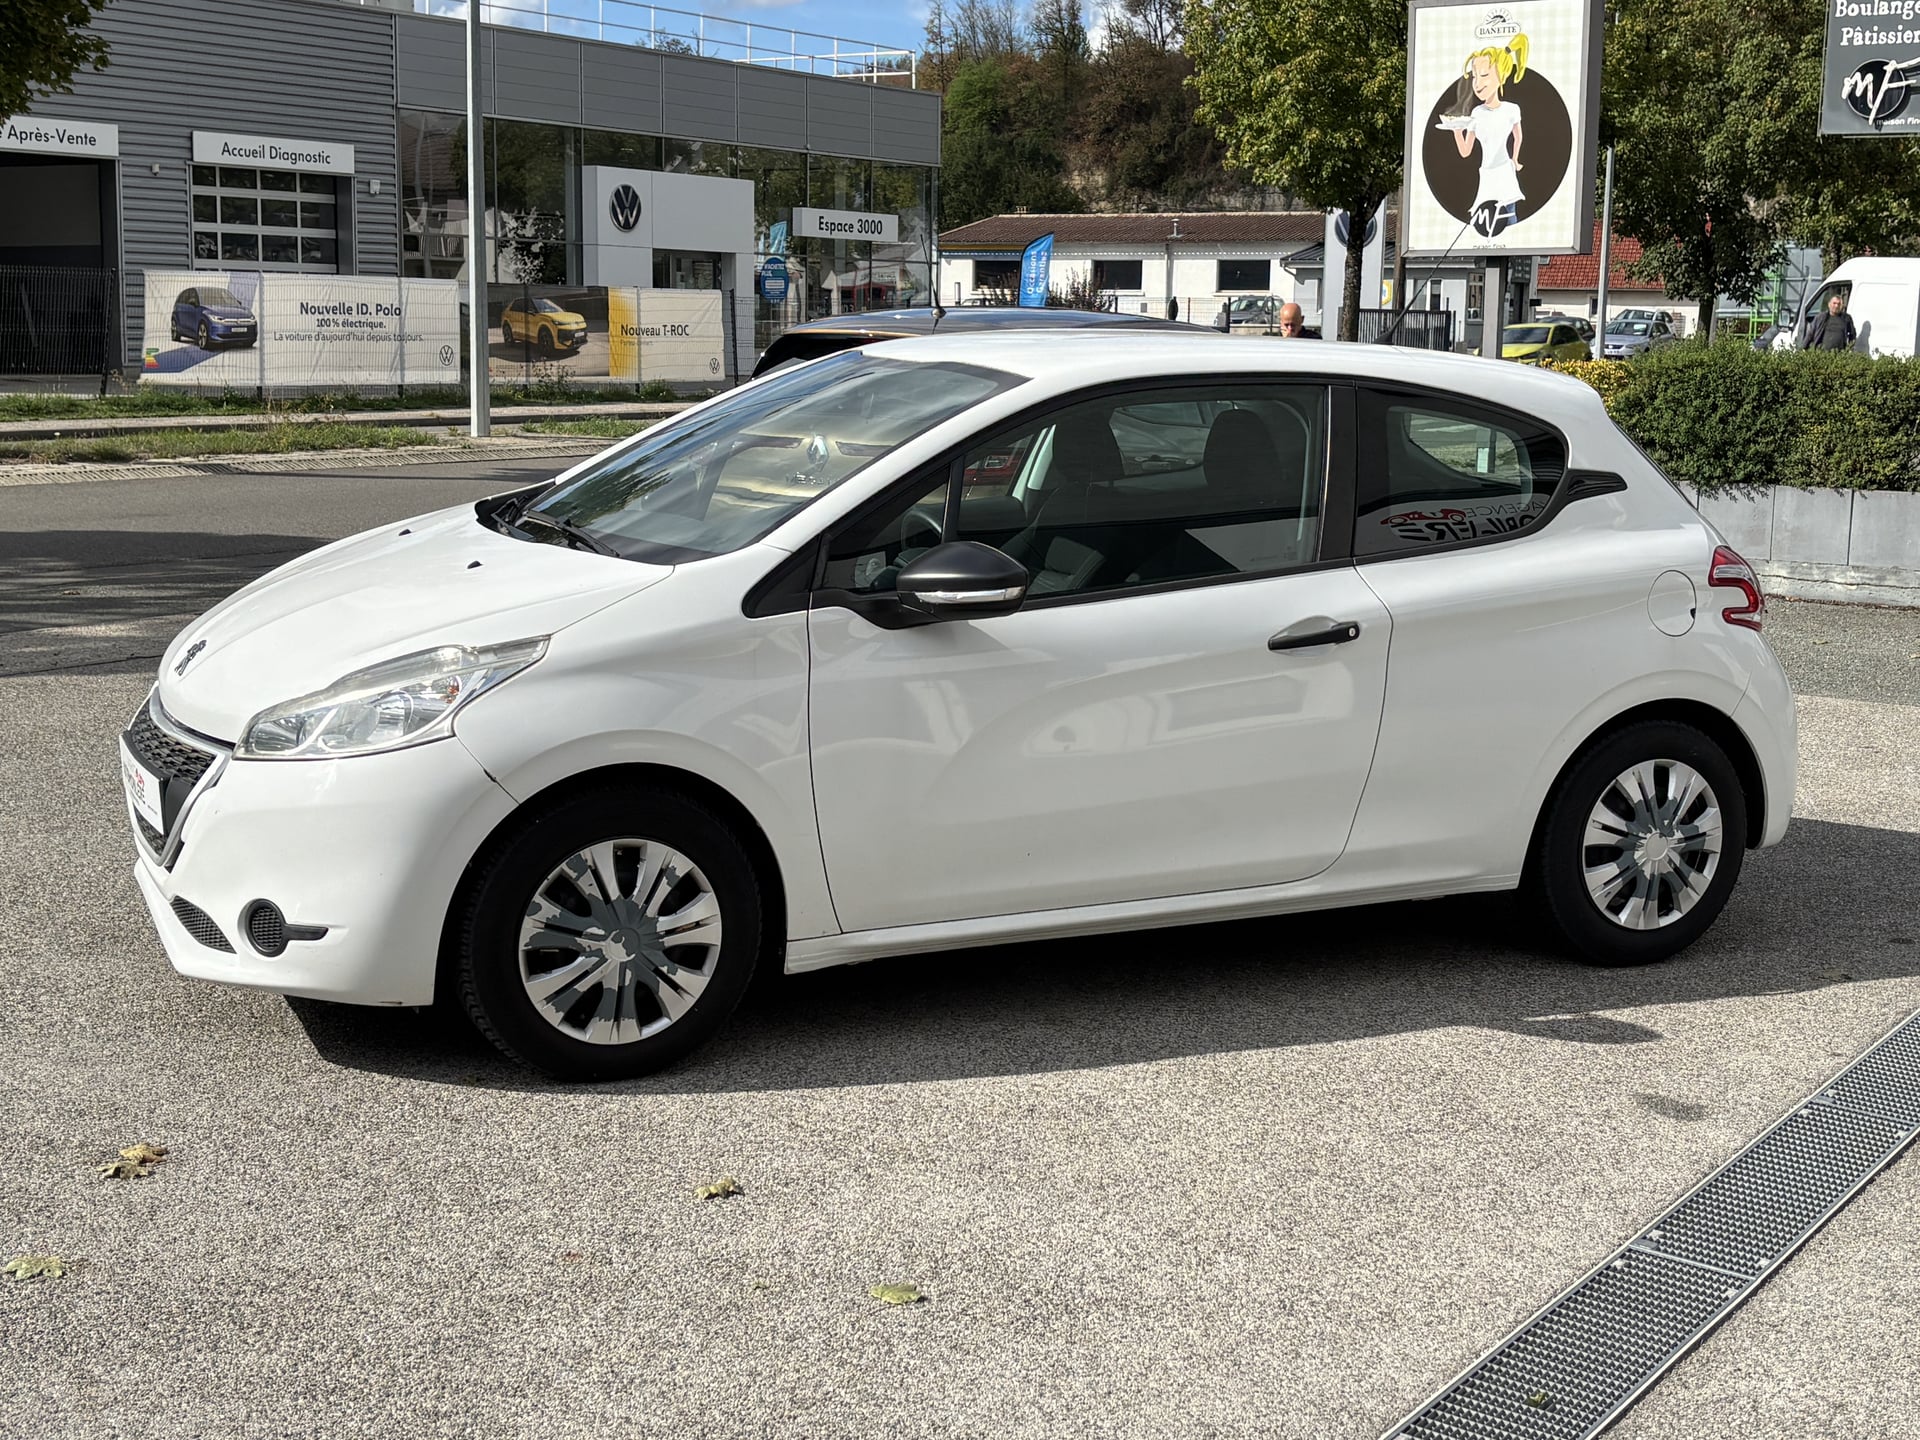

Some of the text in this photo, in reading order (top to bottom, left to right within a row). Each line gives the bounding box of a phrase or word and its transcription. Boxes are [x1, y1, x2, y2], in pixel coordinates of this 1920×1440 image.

[1479, 26, 1517, 35] BANETTE
[7, 124, 97, 146] Après-Vente
[221, 141, 332, 165] Accueil Diagnostic
[818, 215, 883, 235] Espace 3000
[1026, 250, 1037, 294] Occasions
[300, 302, 402, 317] Nouvelle ID. Polo
[341, 318, 387, 330] électrique.
[620, 324, 690, 337] Nouveau T-ROC
[273, 332, 283, 342] La
[285, 332, 313, 342] voiture
[366, 332, 392, 345] depuis
